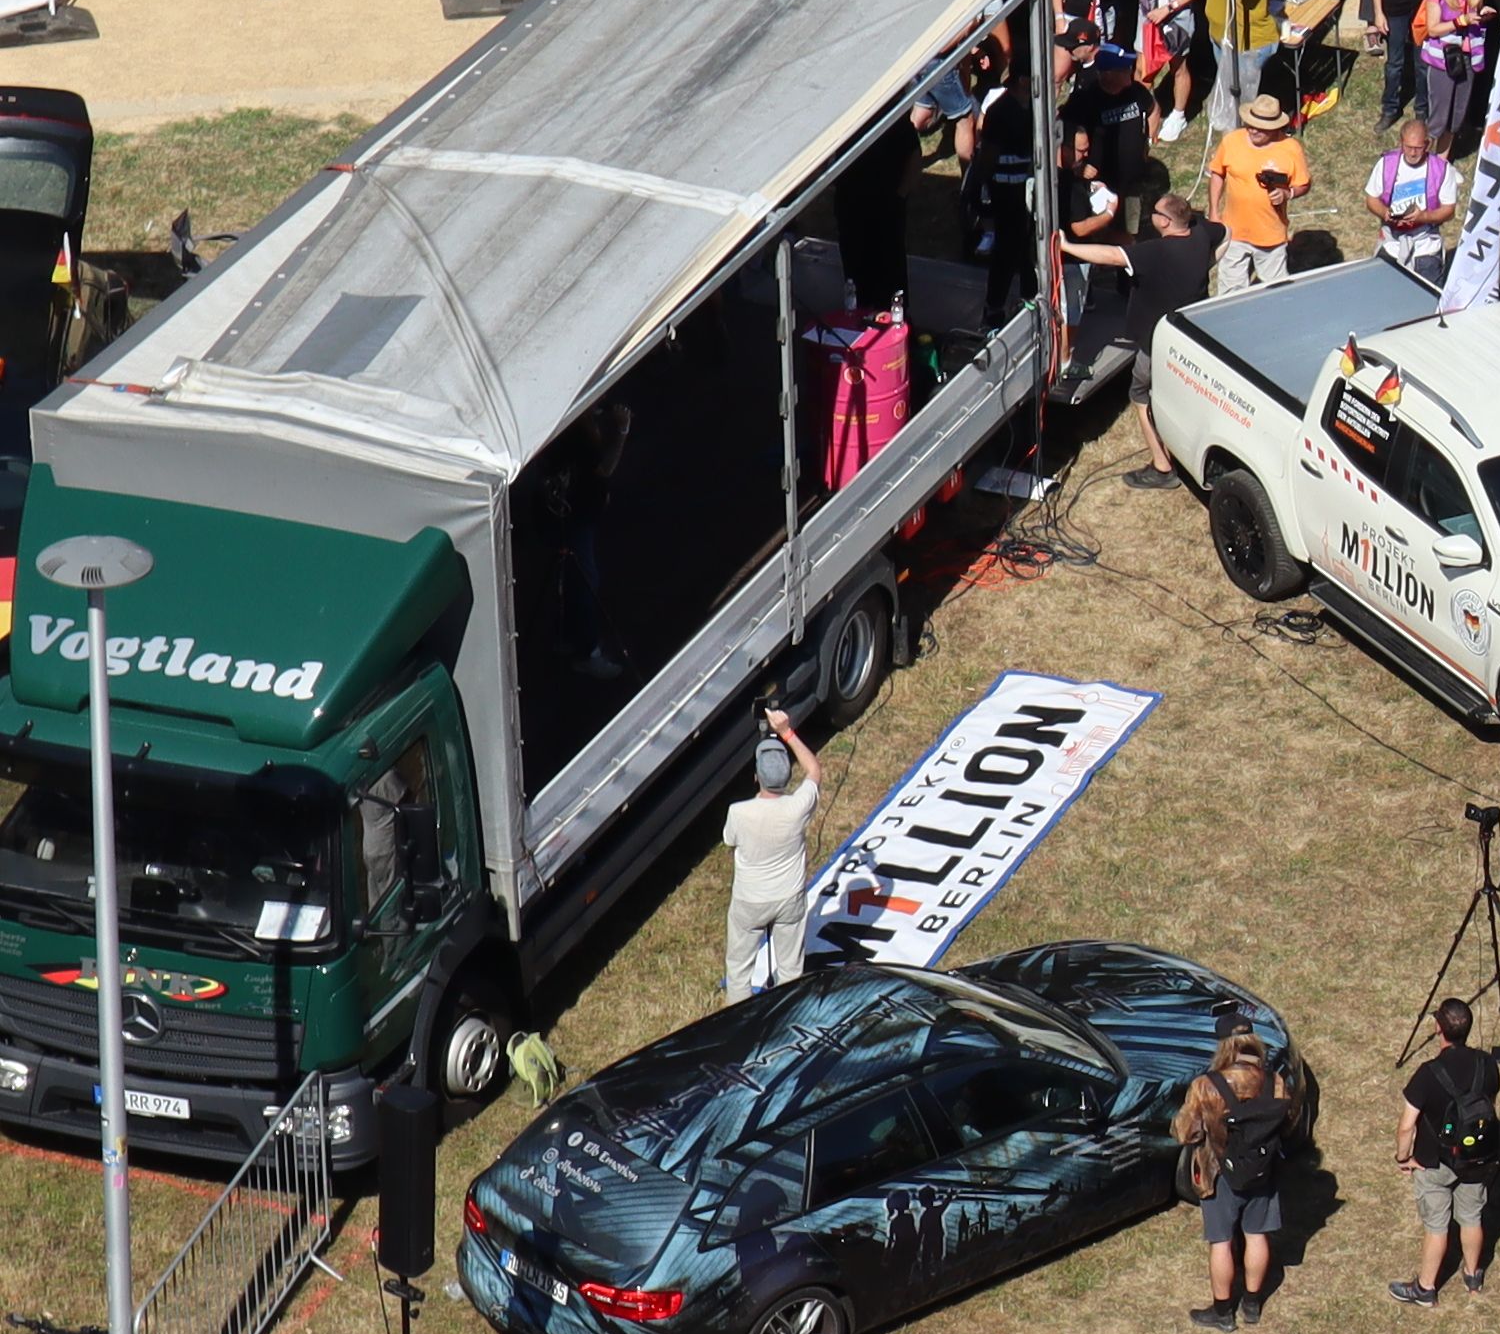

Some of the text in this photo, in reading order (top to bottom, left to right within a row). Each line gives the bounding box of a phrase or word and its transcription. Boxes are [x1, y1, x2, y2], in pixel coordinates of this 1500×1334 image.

[1179, 351, 1202, 380] PARTEI
[1361, 520, 1415, 571] PROJEKT
[1367, 578, 1408, 616] BERLIN
[28, 613, 323, 701] Vogtland
[922, 800, 1047, 934] BERLIN
[129, 1093, 182, 1115] RR 974
